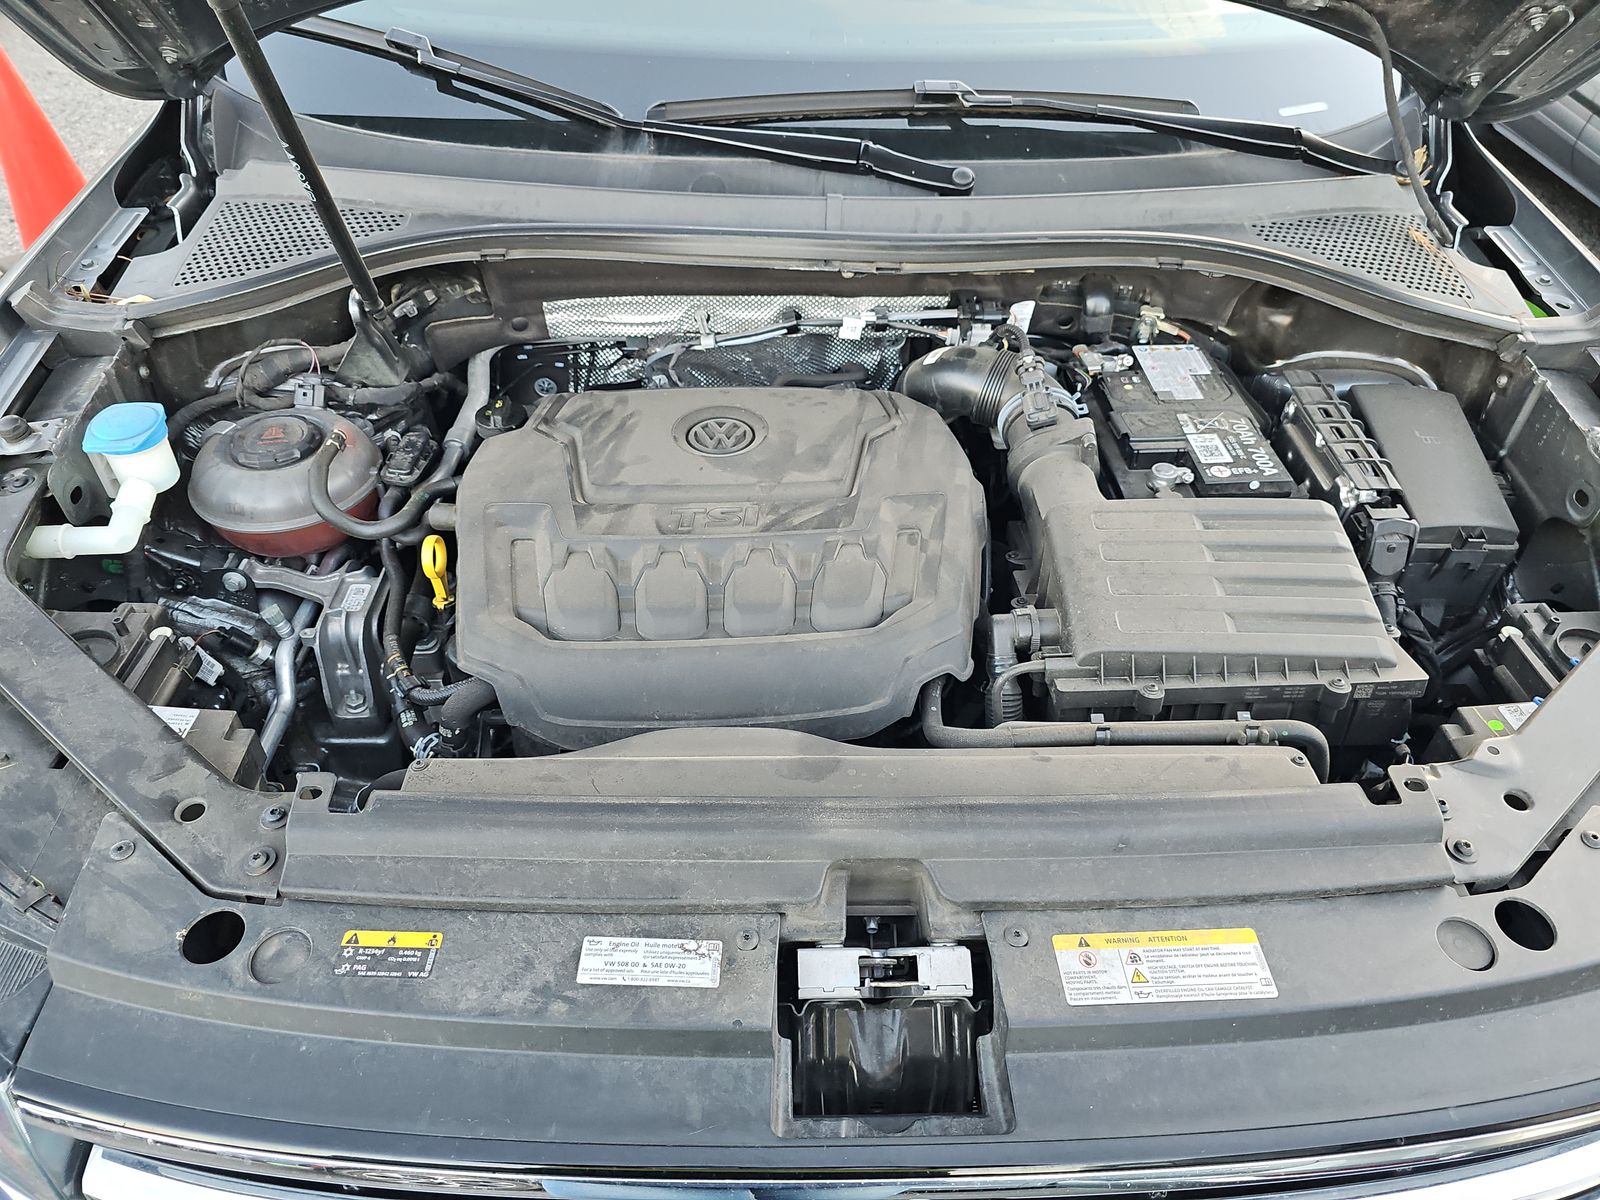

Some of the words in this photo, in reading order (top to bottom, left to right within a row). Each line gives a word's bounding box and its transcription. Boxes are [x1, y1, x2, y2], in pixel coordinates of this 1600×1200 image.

[1248, 446, 1279, 476] 700A
[671, 506, 760, 529] TSI
[1104, 937, 1141, 945] WARNING
[1147, 935, 1188, 943] ATTENTION
